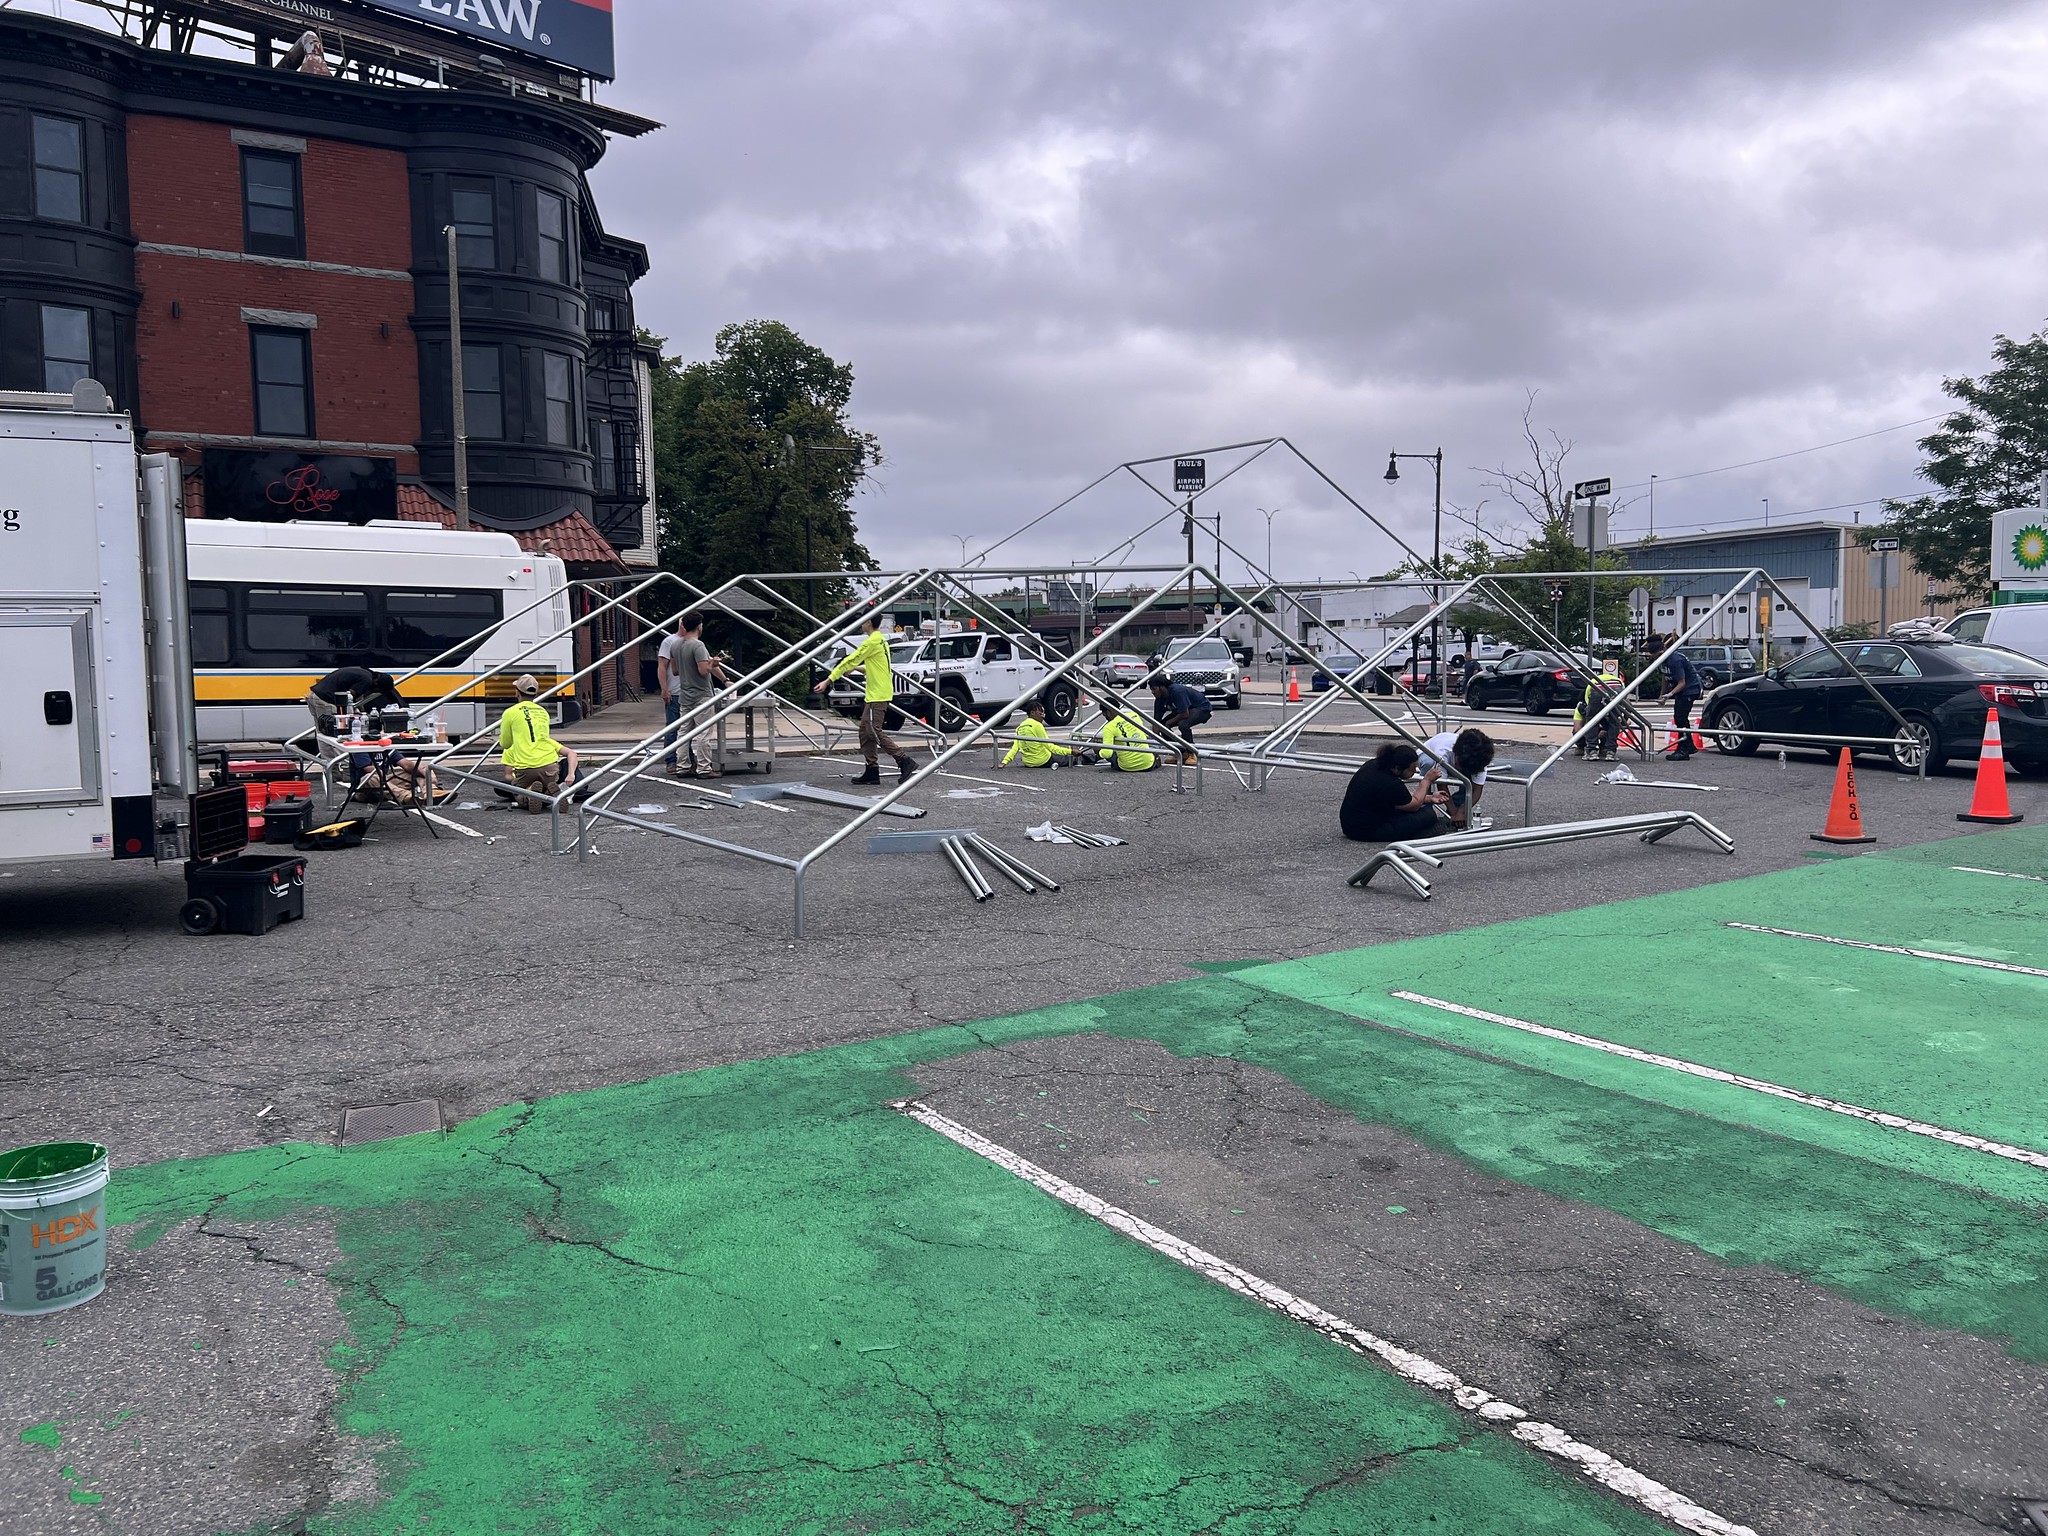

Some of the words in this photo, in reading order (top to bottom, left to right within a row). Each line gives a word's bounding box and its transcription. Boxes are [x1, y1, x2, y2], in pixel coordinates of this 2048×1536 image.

[418, 0, 542, 41] AW
[1584, 485, 1594, 494] ONE
[1596, 483, 1607, 491] WAY
[1846, 763, 1856, 797] TECH
[1849, 803, 1859, 820] SQ
[31, 1206, 98, 1249] HDX
[35, 1266, 58, 1291] 5
[36, 1273, 98, 1301] GALLONS
